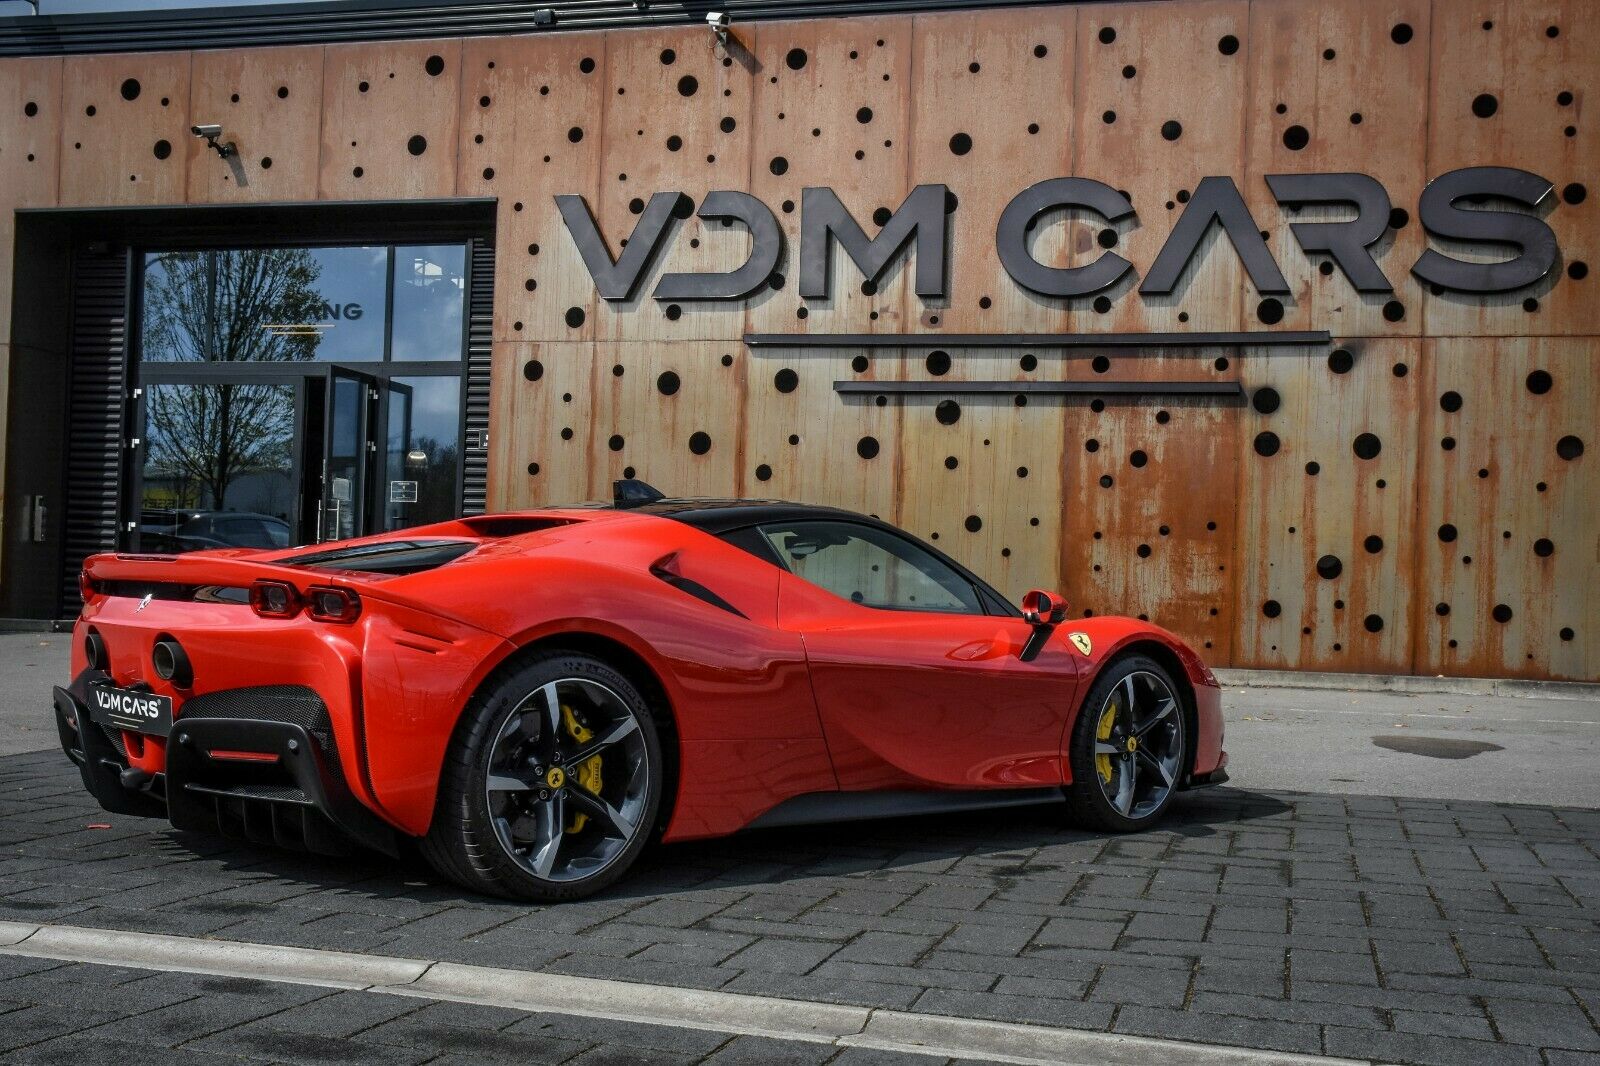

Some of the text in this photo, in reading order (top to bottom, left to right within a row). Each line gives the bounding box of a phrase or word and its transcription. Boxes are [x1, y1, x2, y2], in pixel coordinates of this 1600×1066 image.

[554, 166, 1557, 301] VDM CARS
[239, 302, 363, 321] NGANG
[95, 690, 121, 711] VDM
